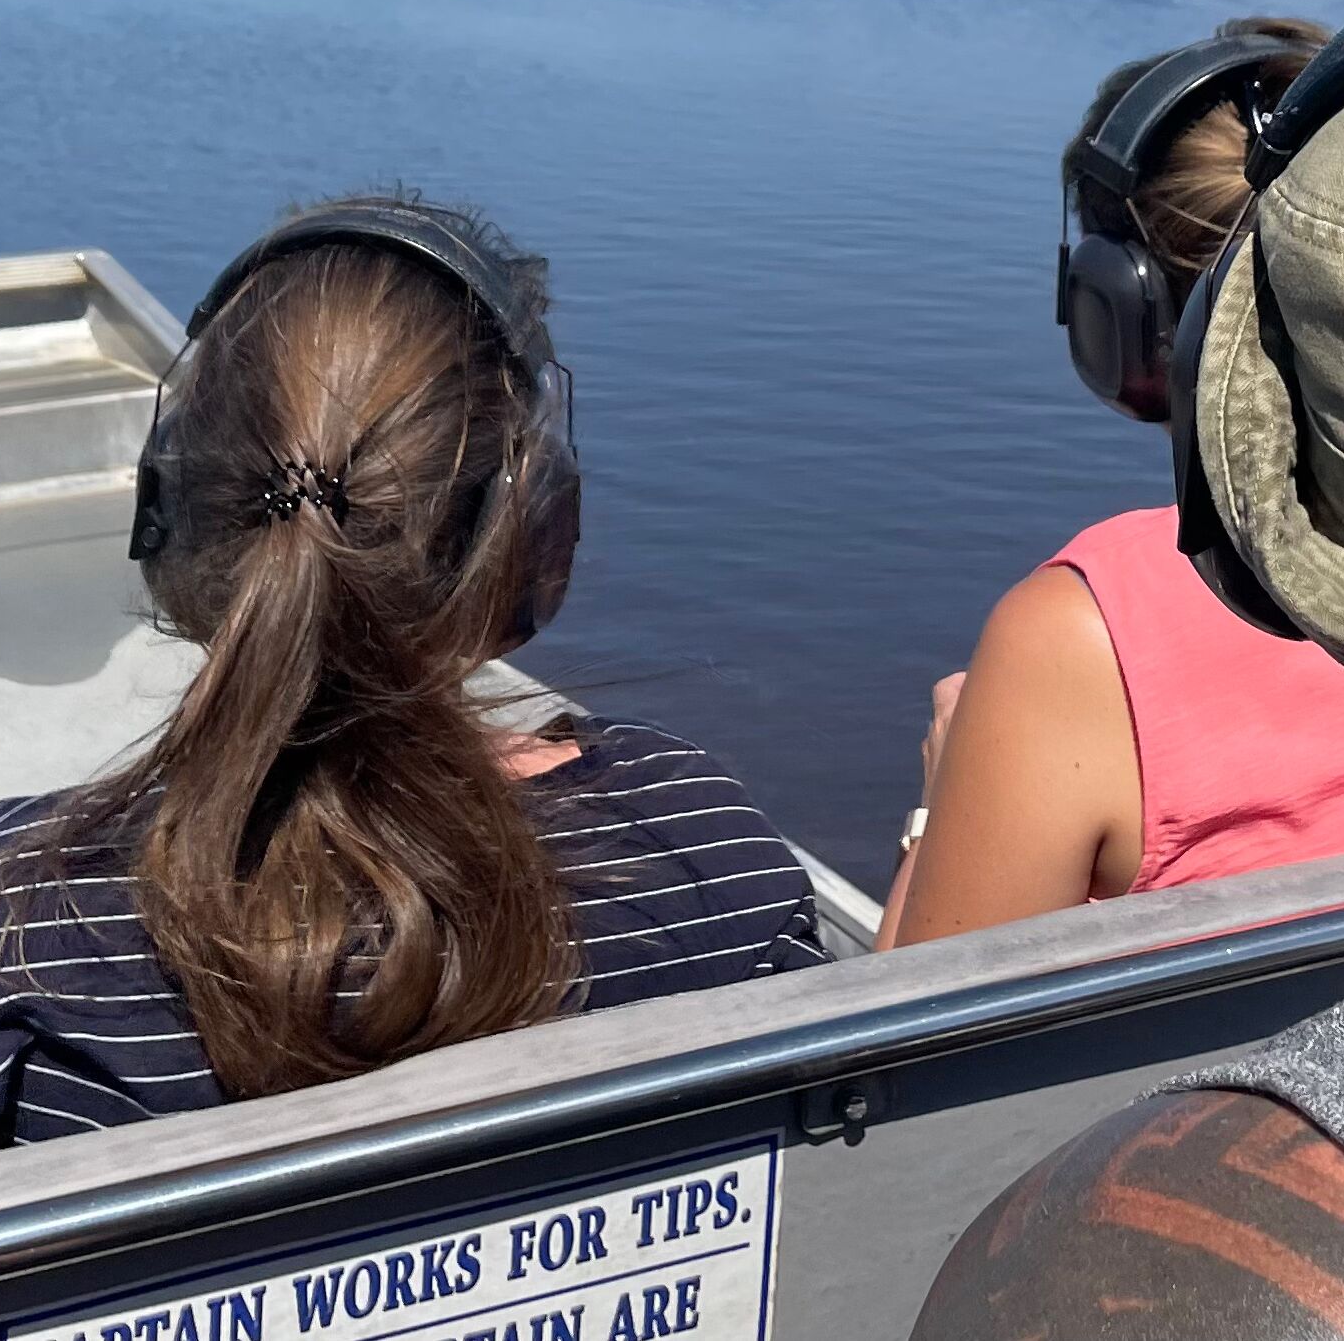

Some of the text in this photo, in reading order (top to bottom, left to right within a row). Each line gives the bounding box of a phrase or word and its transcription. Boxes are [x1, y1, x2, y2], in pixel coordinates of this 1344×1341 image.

[47, 1286, 266, 1341] TAIN
[293, 1233, 481, 1333] WORKS
[507, 1206, 608, 1281] FOR
[631, 1171, 752, 1249] TIPS.
[607, 1274, 701, 1341] ARE
